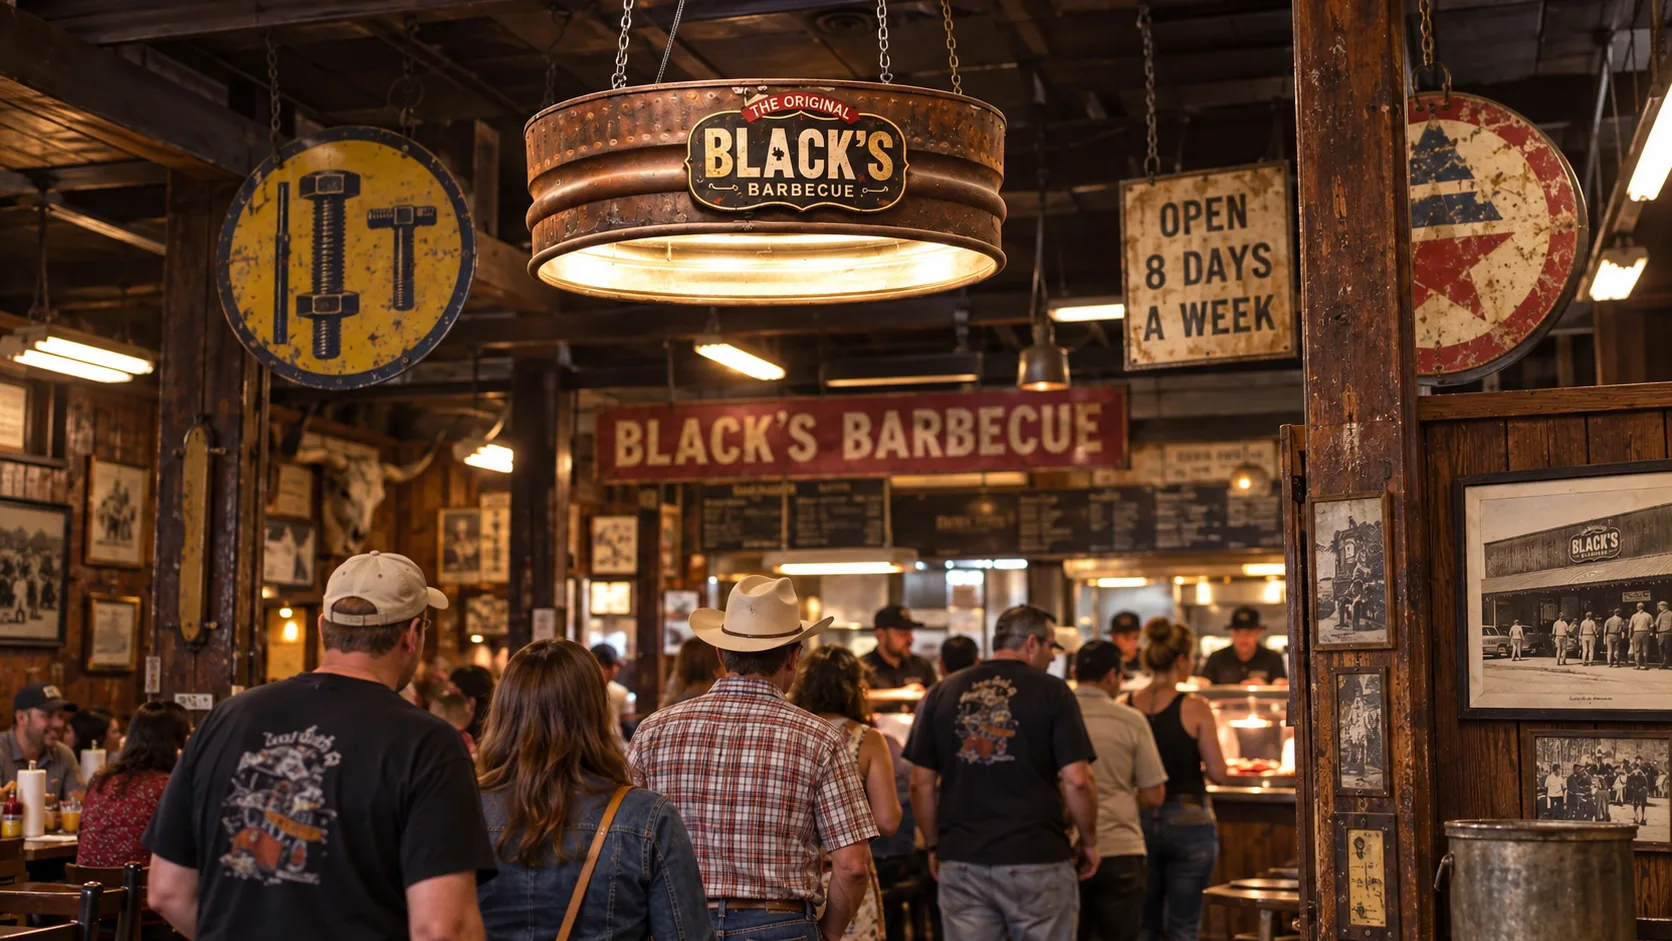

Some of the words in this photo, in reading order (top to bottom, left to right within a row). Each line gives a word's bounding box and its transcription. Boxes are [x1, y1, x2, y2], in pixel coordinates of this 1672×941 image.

[749, 98, 780, 118] THE
[784, 95, 850, 120] ORIGINAL
[704, 127, 894, 181] BLACK'S
[748, 183, 855, 198] BARBECUE
[1159, 193, 1248, 238] OPEN
[1145, 254, 1166, 290] 8
[1183, 242, 1273, 287] DAYS
[1143, 305, 1165, 342] A
[1180, 294, 1276, 338] WEEK
[615, 409, 818, 467] BLACK'S
[842, 403, 1102, 461] BARBECUE
[1572, 532, 1619, 554] BLACK'S
